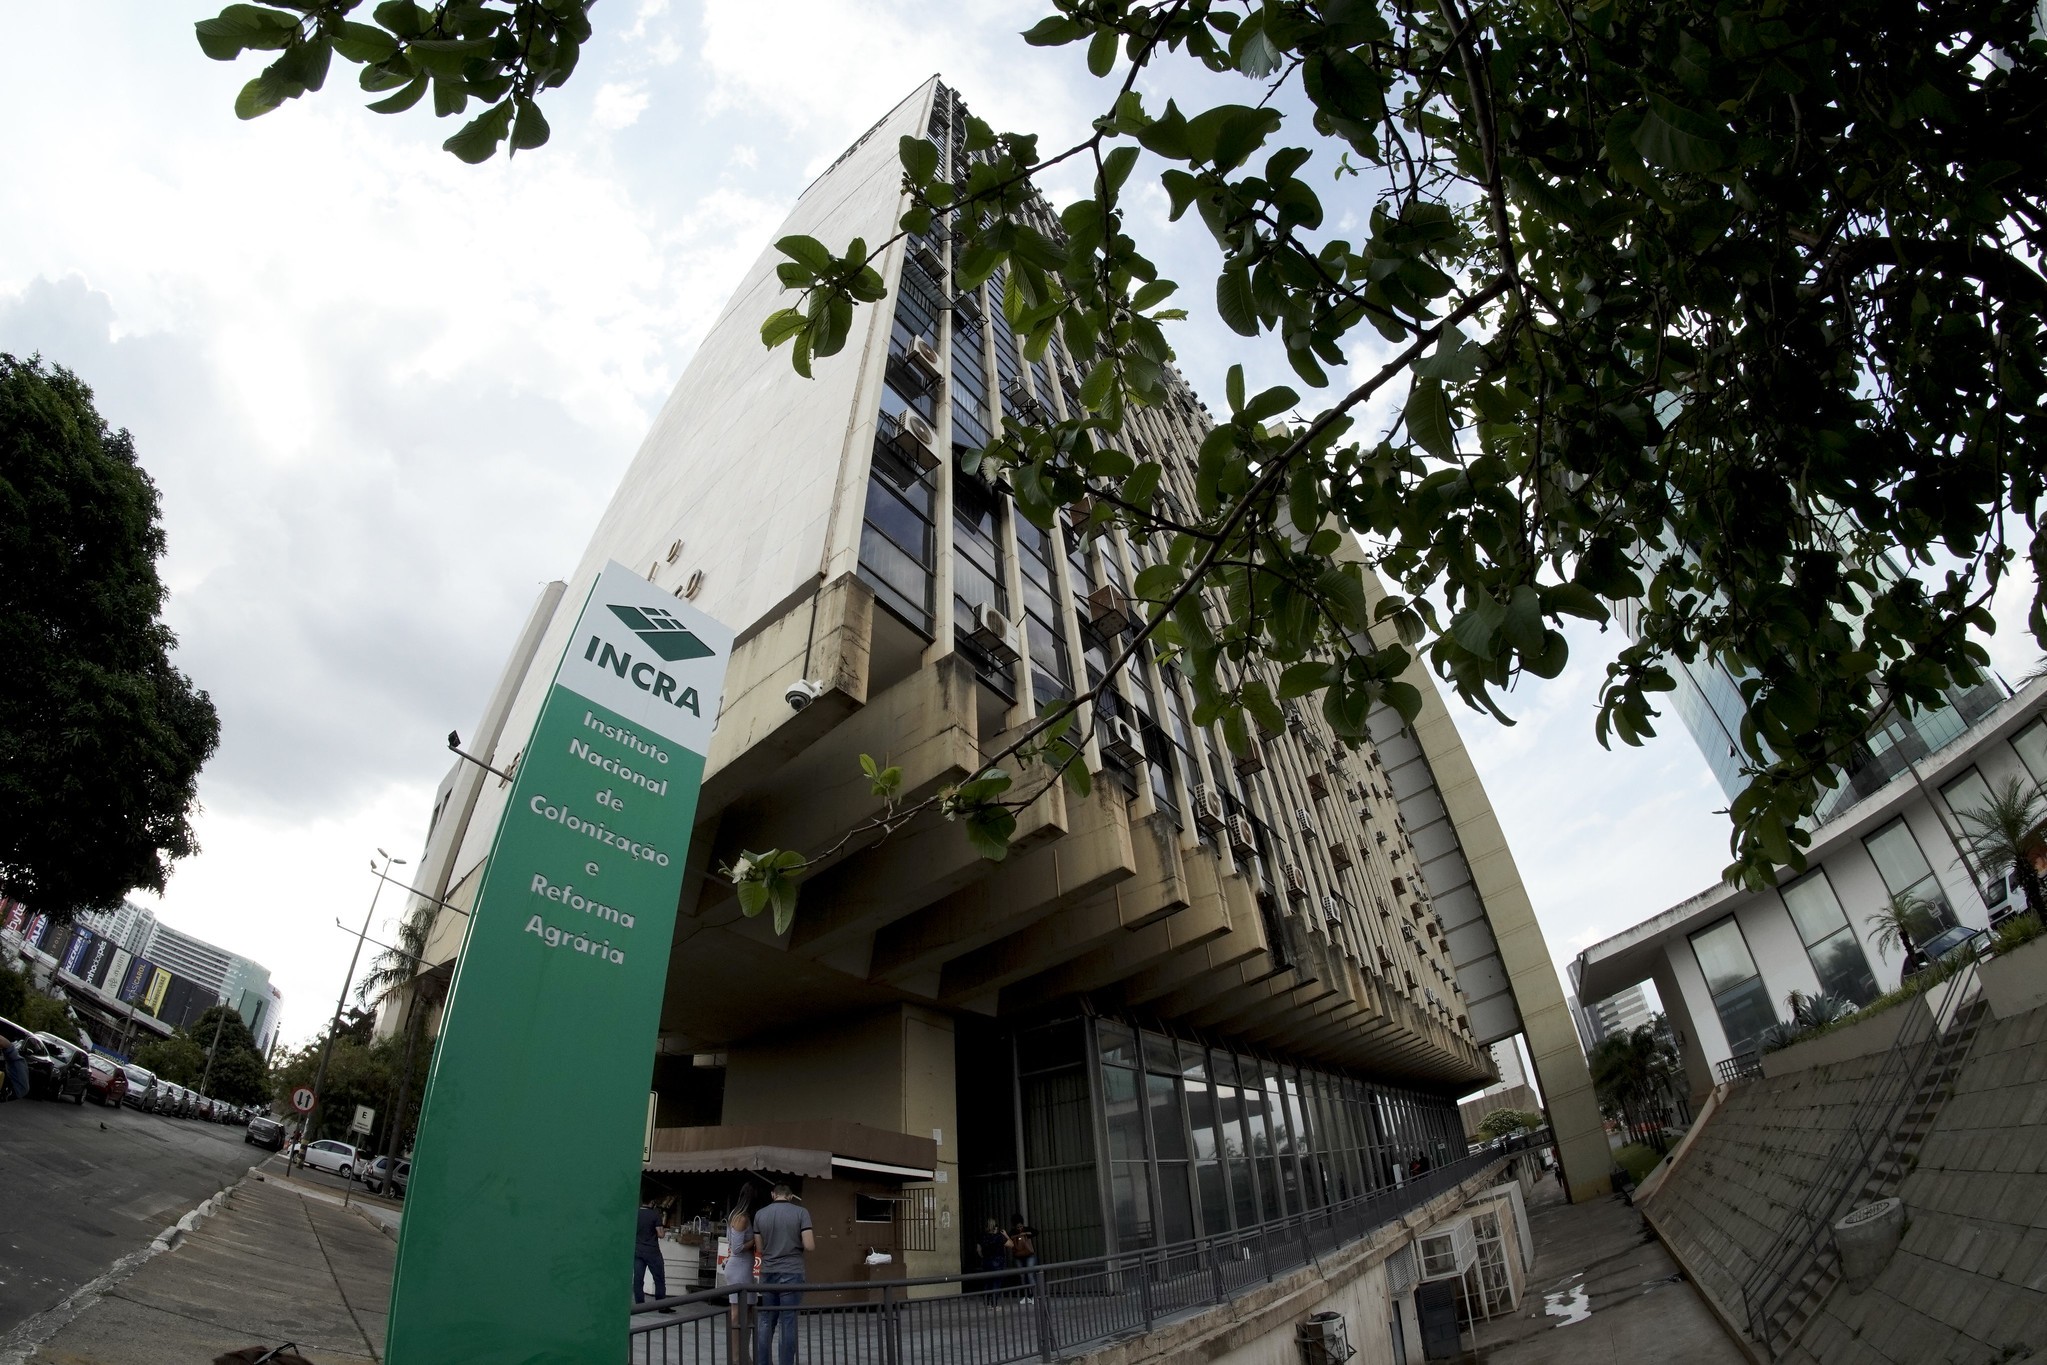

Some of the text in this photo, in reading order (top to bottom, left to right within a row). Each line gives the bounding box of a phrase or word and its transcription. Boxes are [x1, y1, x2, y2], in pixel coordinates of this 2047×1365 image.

[584, 635, 700, 718] INCRA
[584, 710, 668, 764] Instituto
[569, 737, 668, 797] Nacional
[596, 788, 624, 812] de
[530, 794, 669, 867] Colonização
[585, 861, 599, 876] e
[530, 873, 635, 929] Reforma
[524, 914, 625, 965] Agrária
